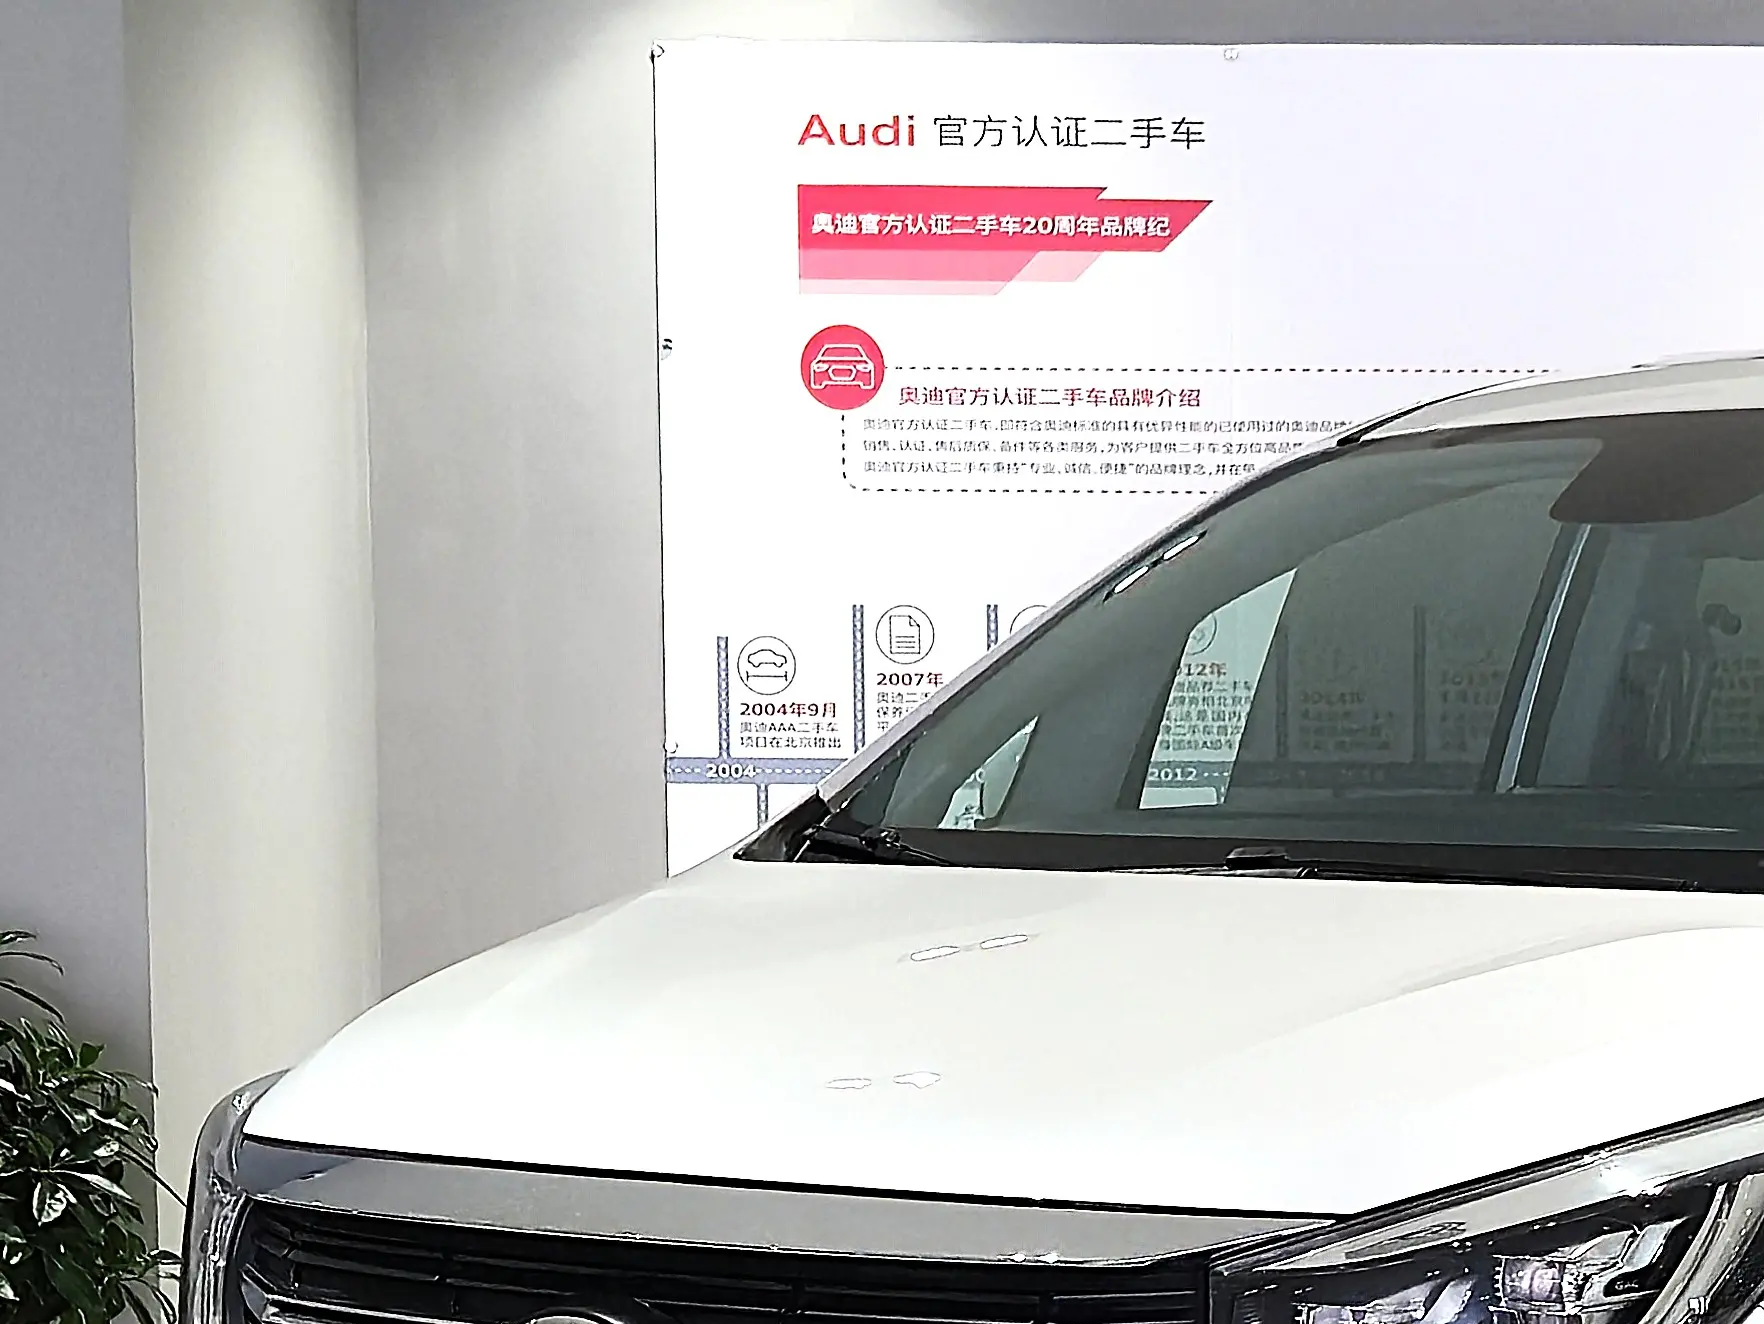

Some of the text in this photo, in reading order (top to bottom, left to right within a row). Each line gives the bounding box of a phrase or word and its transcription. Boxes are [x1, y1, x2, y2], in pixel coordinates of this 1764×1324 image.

[798, 114, 1207, 149] Audi 官方认证二手车
[811, 213, 1171, 237] 奥迪官方认证二手车20周年品牌纪
[898, 386, 1201, 410] 奥迪官方认证二手车品牌介绍
[876, 672, 944, 688] 2007年
[740, 702, 836, 718] 2004年9月
[740, 722, 839, 734] 奥迪AAA二手车
[740, 736, 842, 749] 项目在北京推出
[705, 762, 757, 779] 2004
[1147, 768, 1198, 781] 2012
